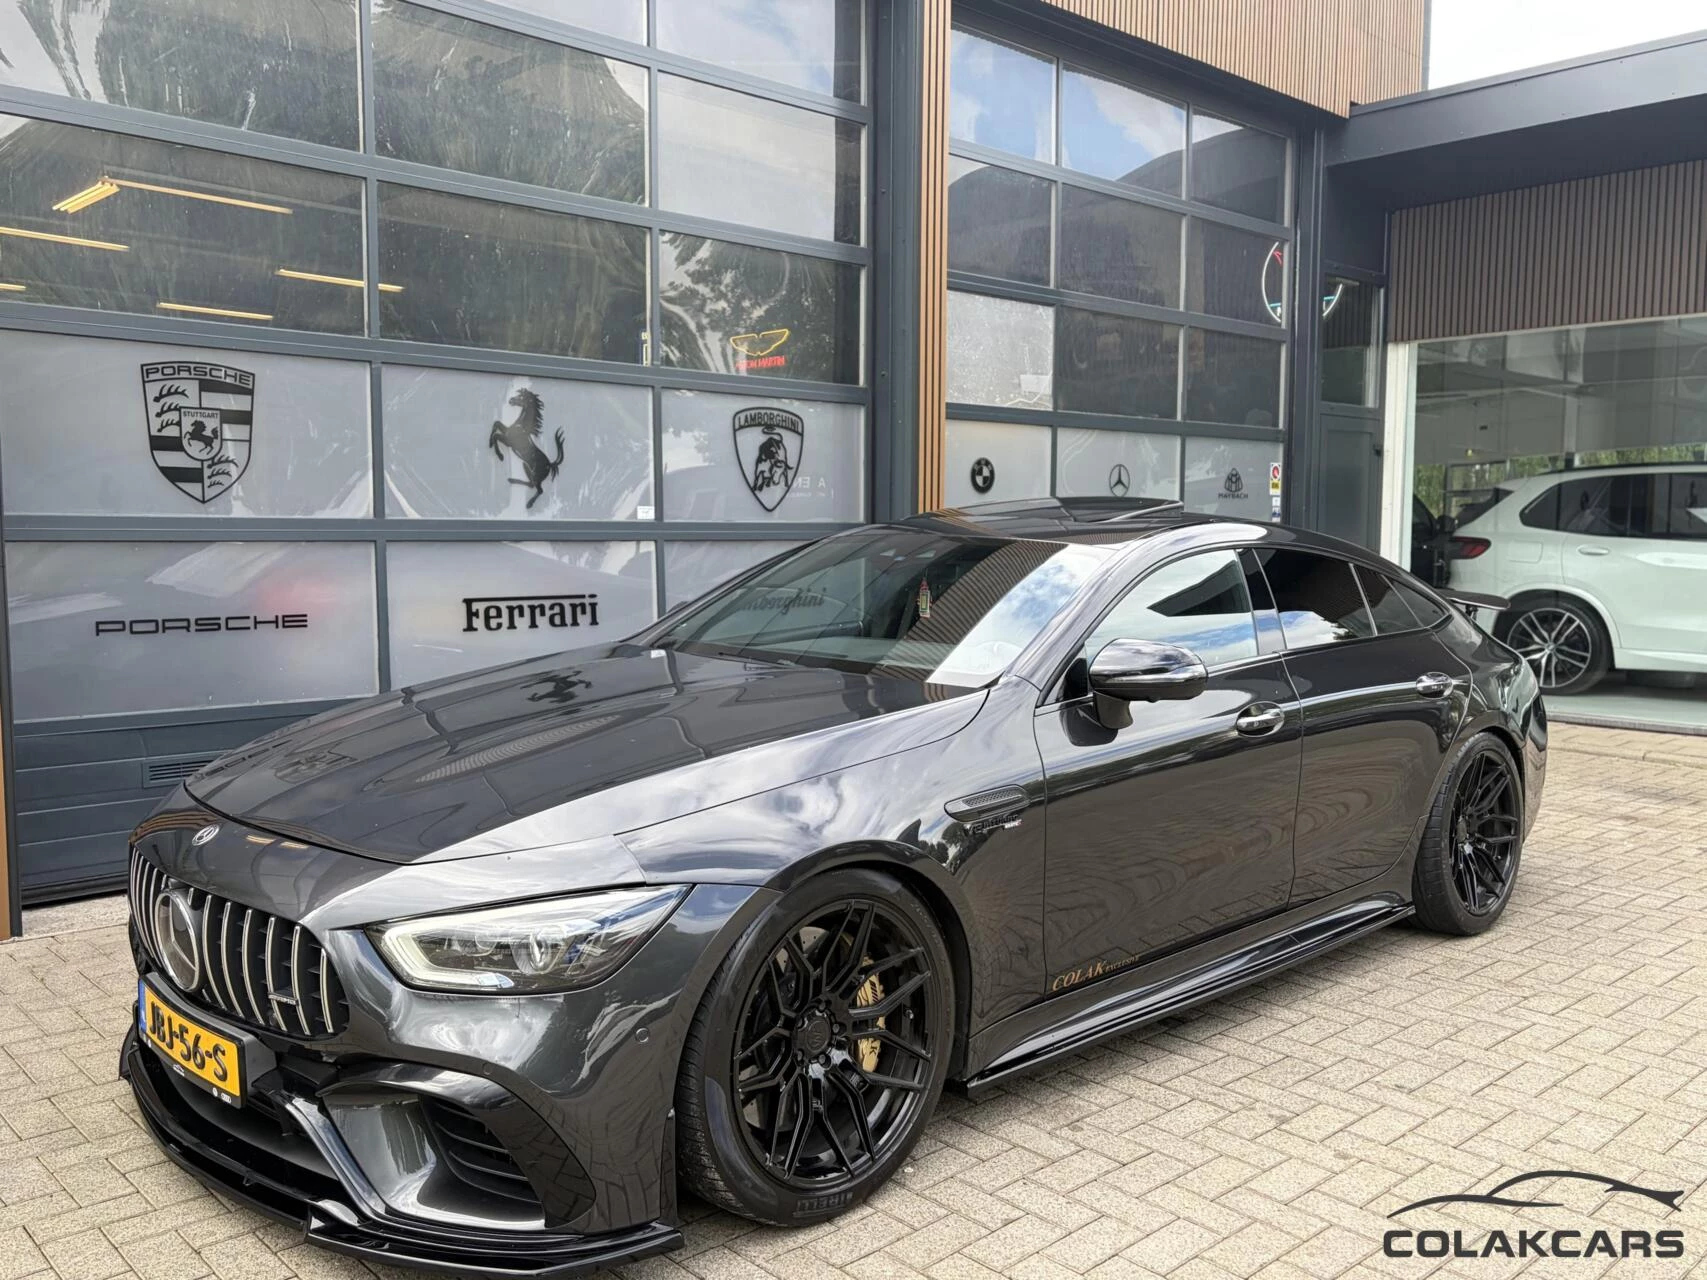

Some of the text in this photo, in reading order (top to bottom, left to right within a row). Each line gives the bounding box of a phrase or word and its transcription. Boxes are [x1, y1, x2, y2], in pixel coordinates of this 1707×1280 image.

[144, 364, 252, 386] PORSCHE
[182, 410, 219, 419] STUTTGART
[738, 411, 800, 433] LAMBORGHINI
[1217, 492, 1249, 500] MAYBACH
[462, 593, 599, 632] Ferrari
[735, 586, 827, 616] mborghini
[95, 613, 308, 637] PORSCHE
[1051, 959, 1107, 992] COLAK
[149, 1000, 228, 1082] JBJ-56-S
